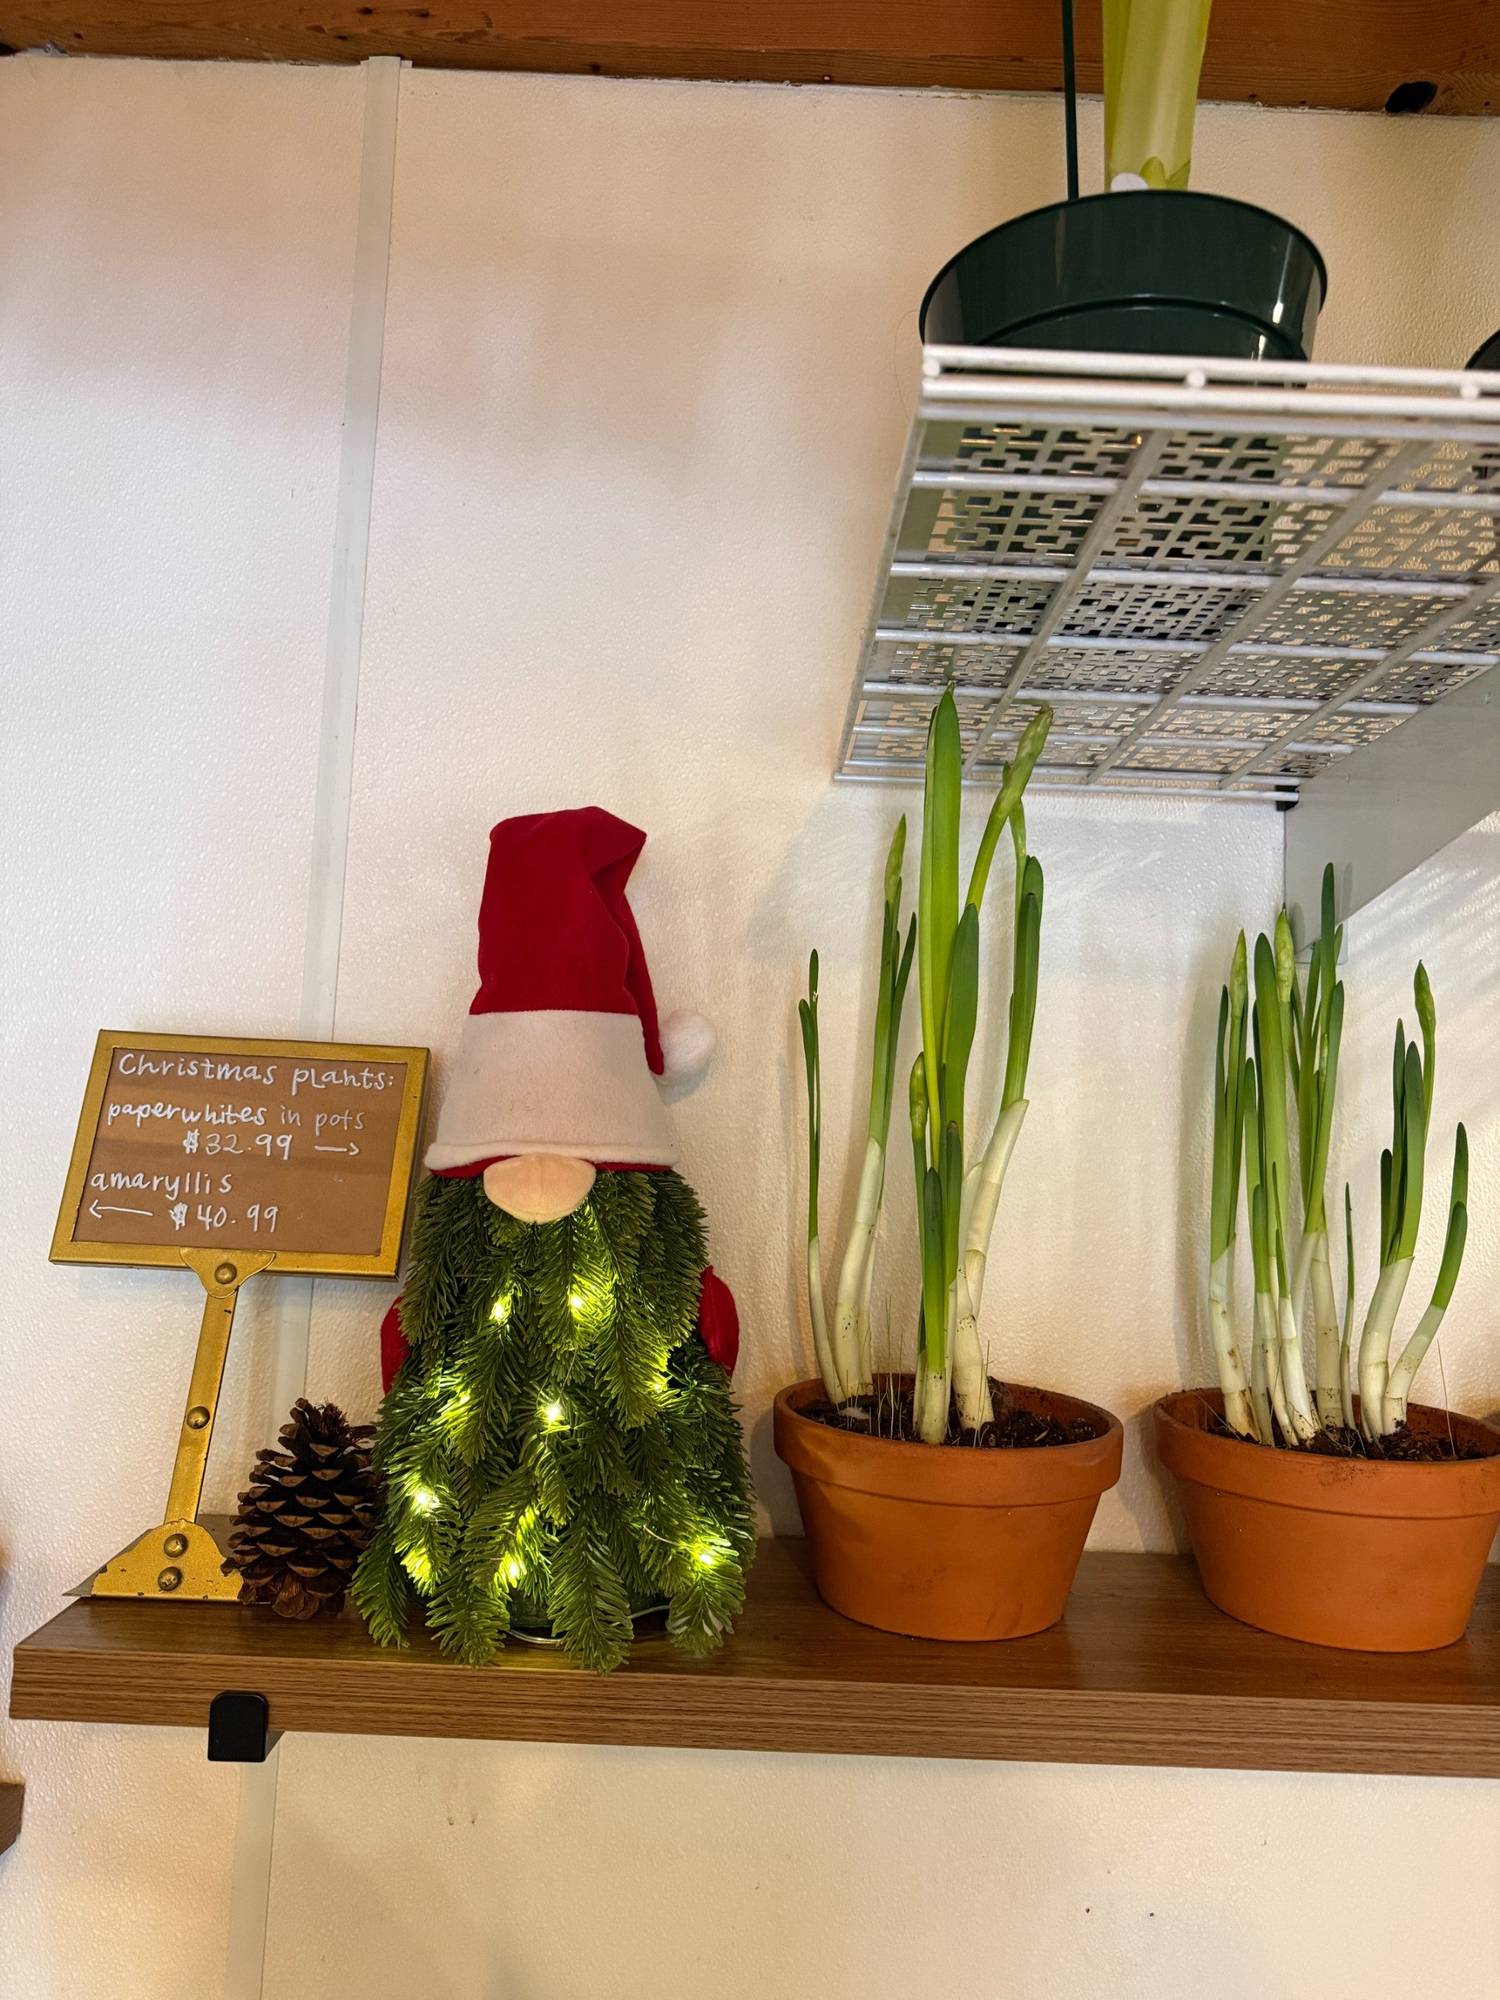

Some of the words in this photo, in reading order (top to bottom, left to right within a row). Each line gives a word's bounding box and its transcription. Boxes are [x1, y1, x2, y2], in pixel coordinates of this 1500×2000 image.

[118, 1053, 278, 1085] Christmas
[292, 1067, 395, 1095] plants:
[107, 1101, 267, 1129] paperwhites
[280, 1105, 301, 1125] in
[314, 1108, 365, 1135] pots
[182, 1129, 293, 1160] $32.99
[90, 1171, 233, 1200] amaryllis
[169, 1202, 279, 1232] $40.99
